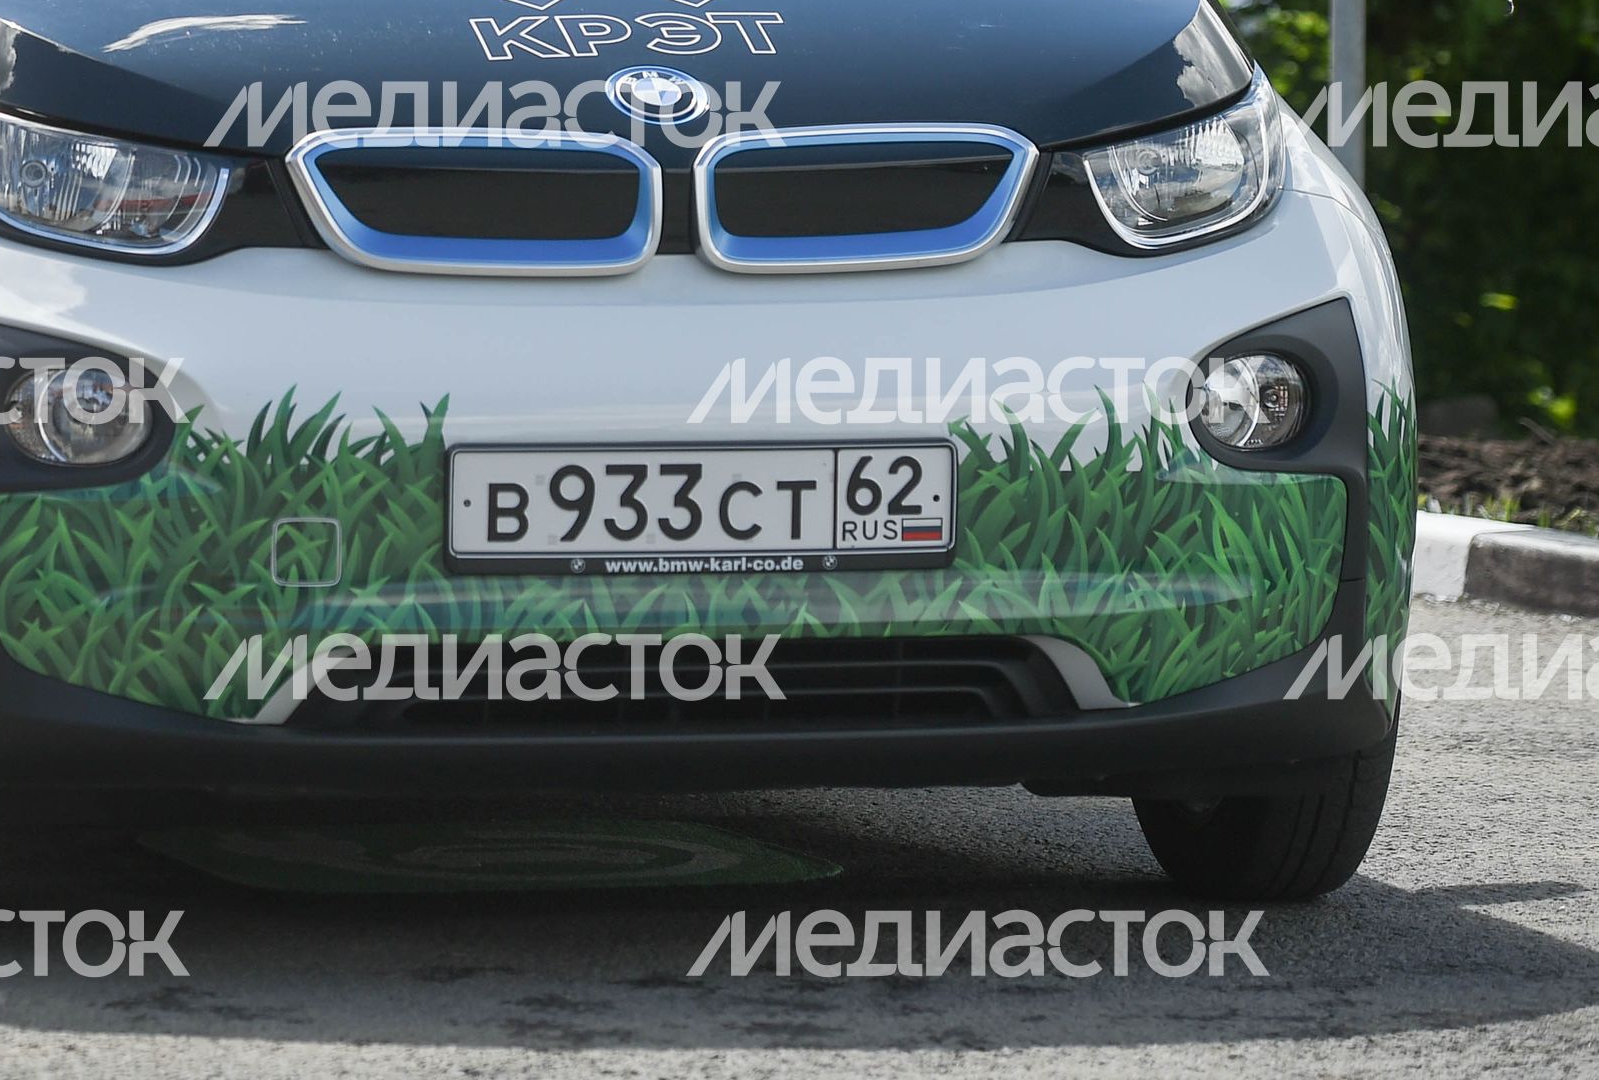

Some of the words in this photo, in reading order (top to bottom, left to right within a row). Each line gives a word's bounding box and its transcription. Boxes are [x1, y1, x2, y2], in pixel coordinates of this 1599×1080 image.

[469, 11, 784, 61] КРЭТ
[846, 455, 922, 516] 62
[842, 519, 898, 541] RUS
[605, 556, 804, 573] www.bmw-karl-co.de
